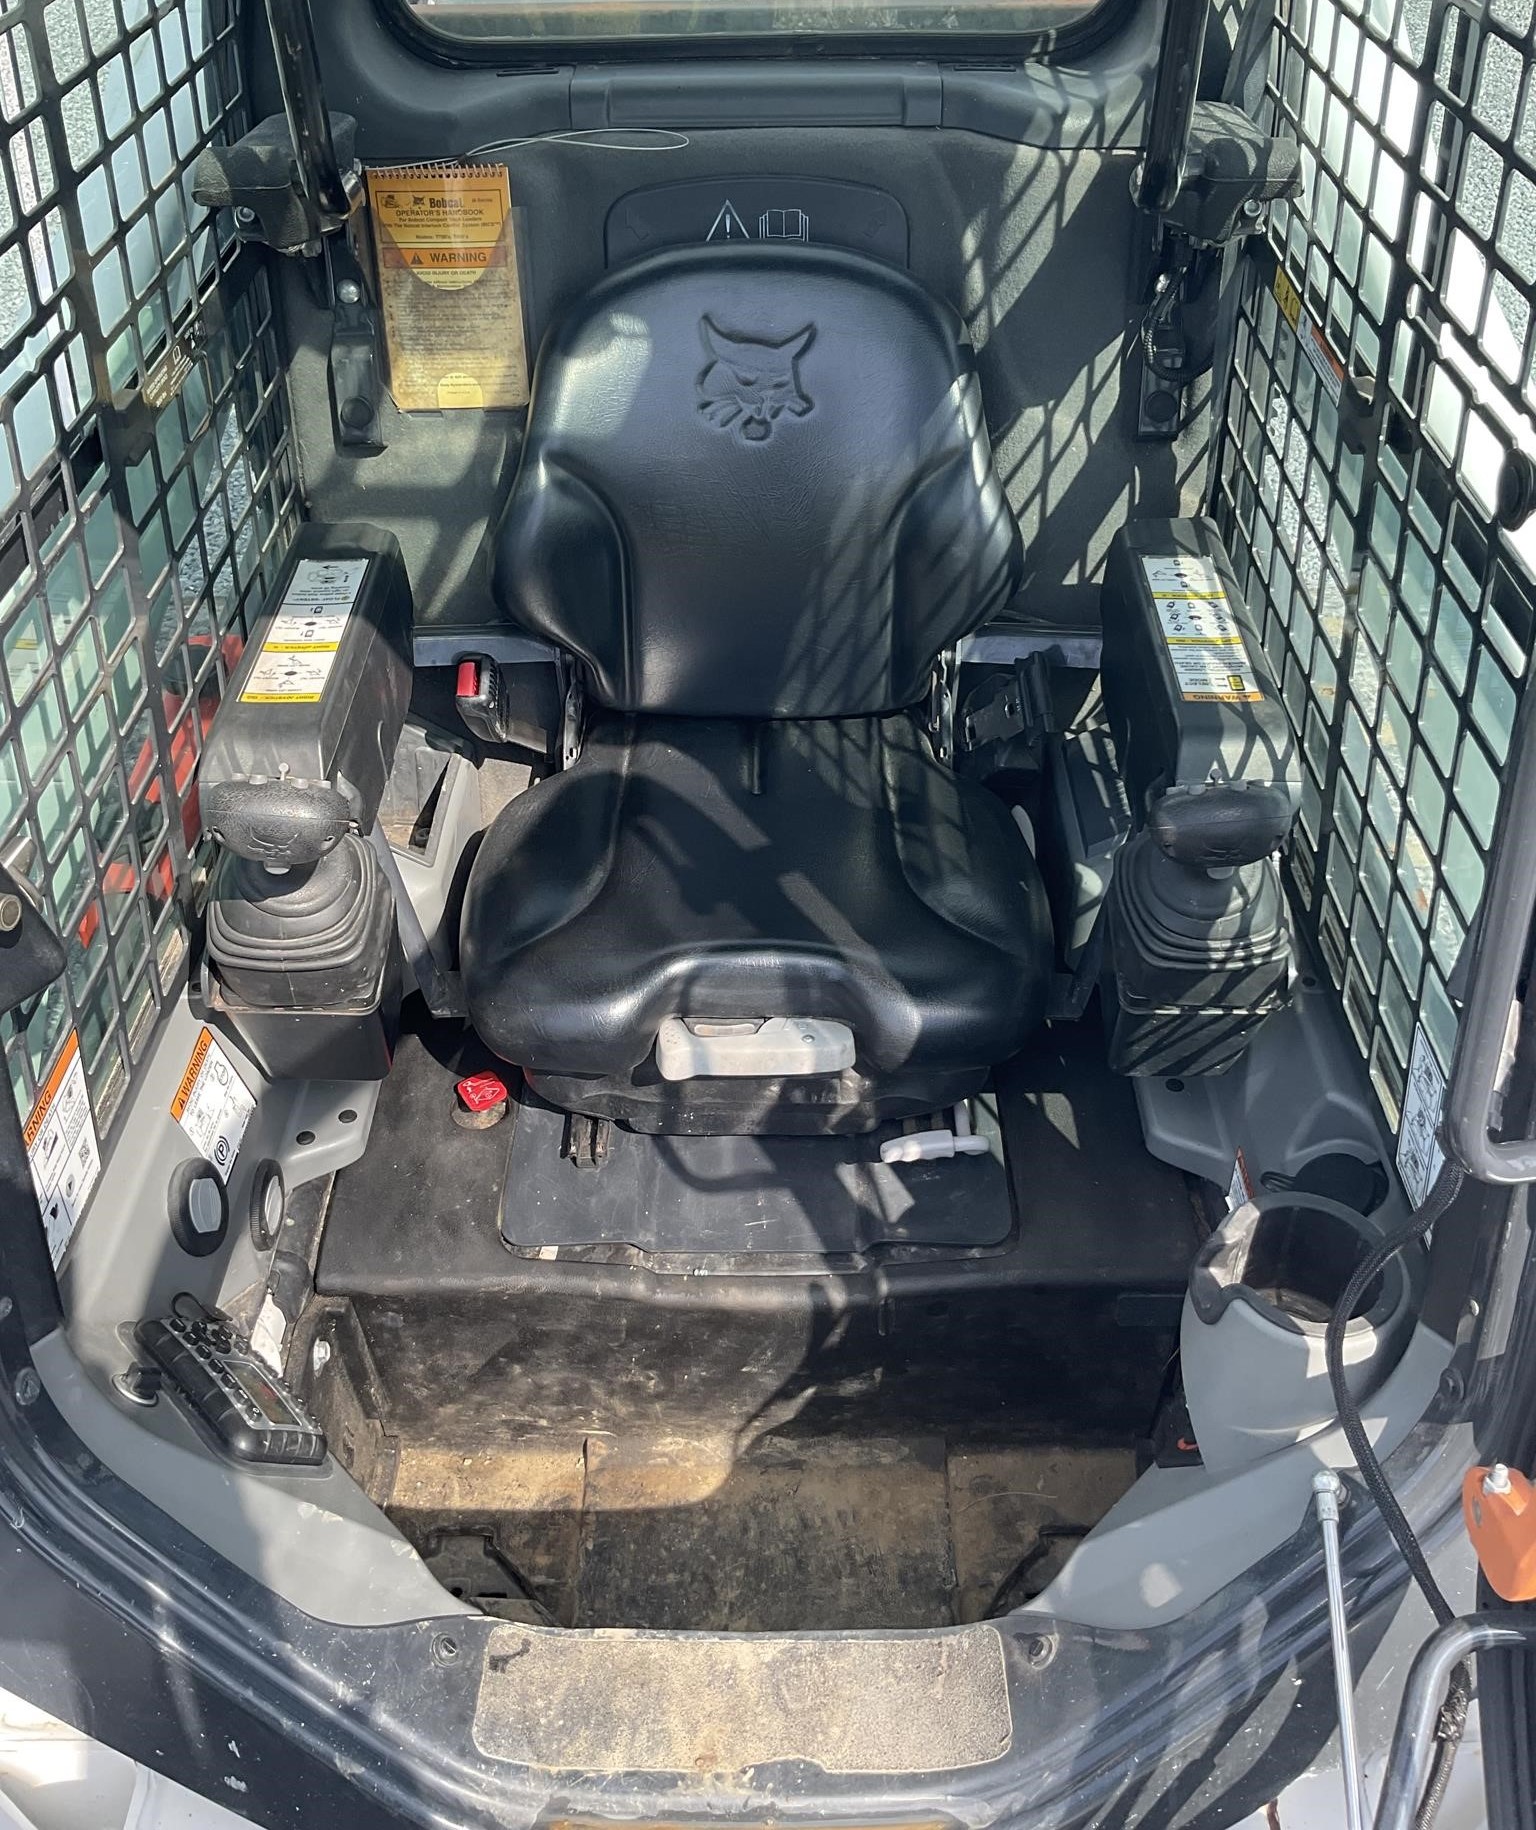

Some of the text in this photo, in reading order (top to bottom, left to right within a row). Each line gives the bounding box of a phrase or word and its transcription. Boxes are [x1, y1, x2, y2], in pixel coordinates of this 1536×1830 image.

[429, 197, 464, 208] Bobcat
[396, 209, 441, 217] OPERATOR'S
[430, 253, 487, 263] WARNING
[184, 1040, 207, 1097] WARNING
[24, 1090, 52, 1146] RNING
